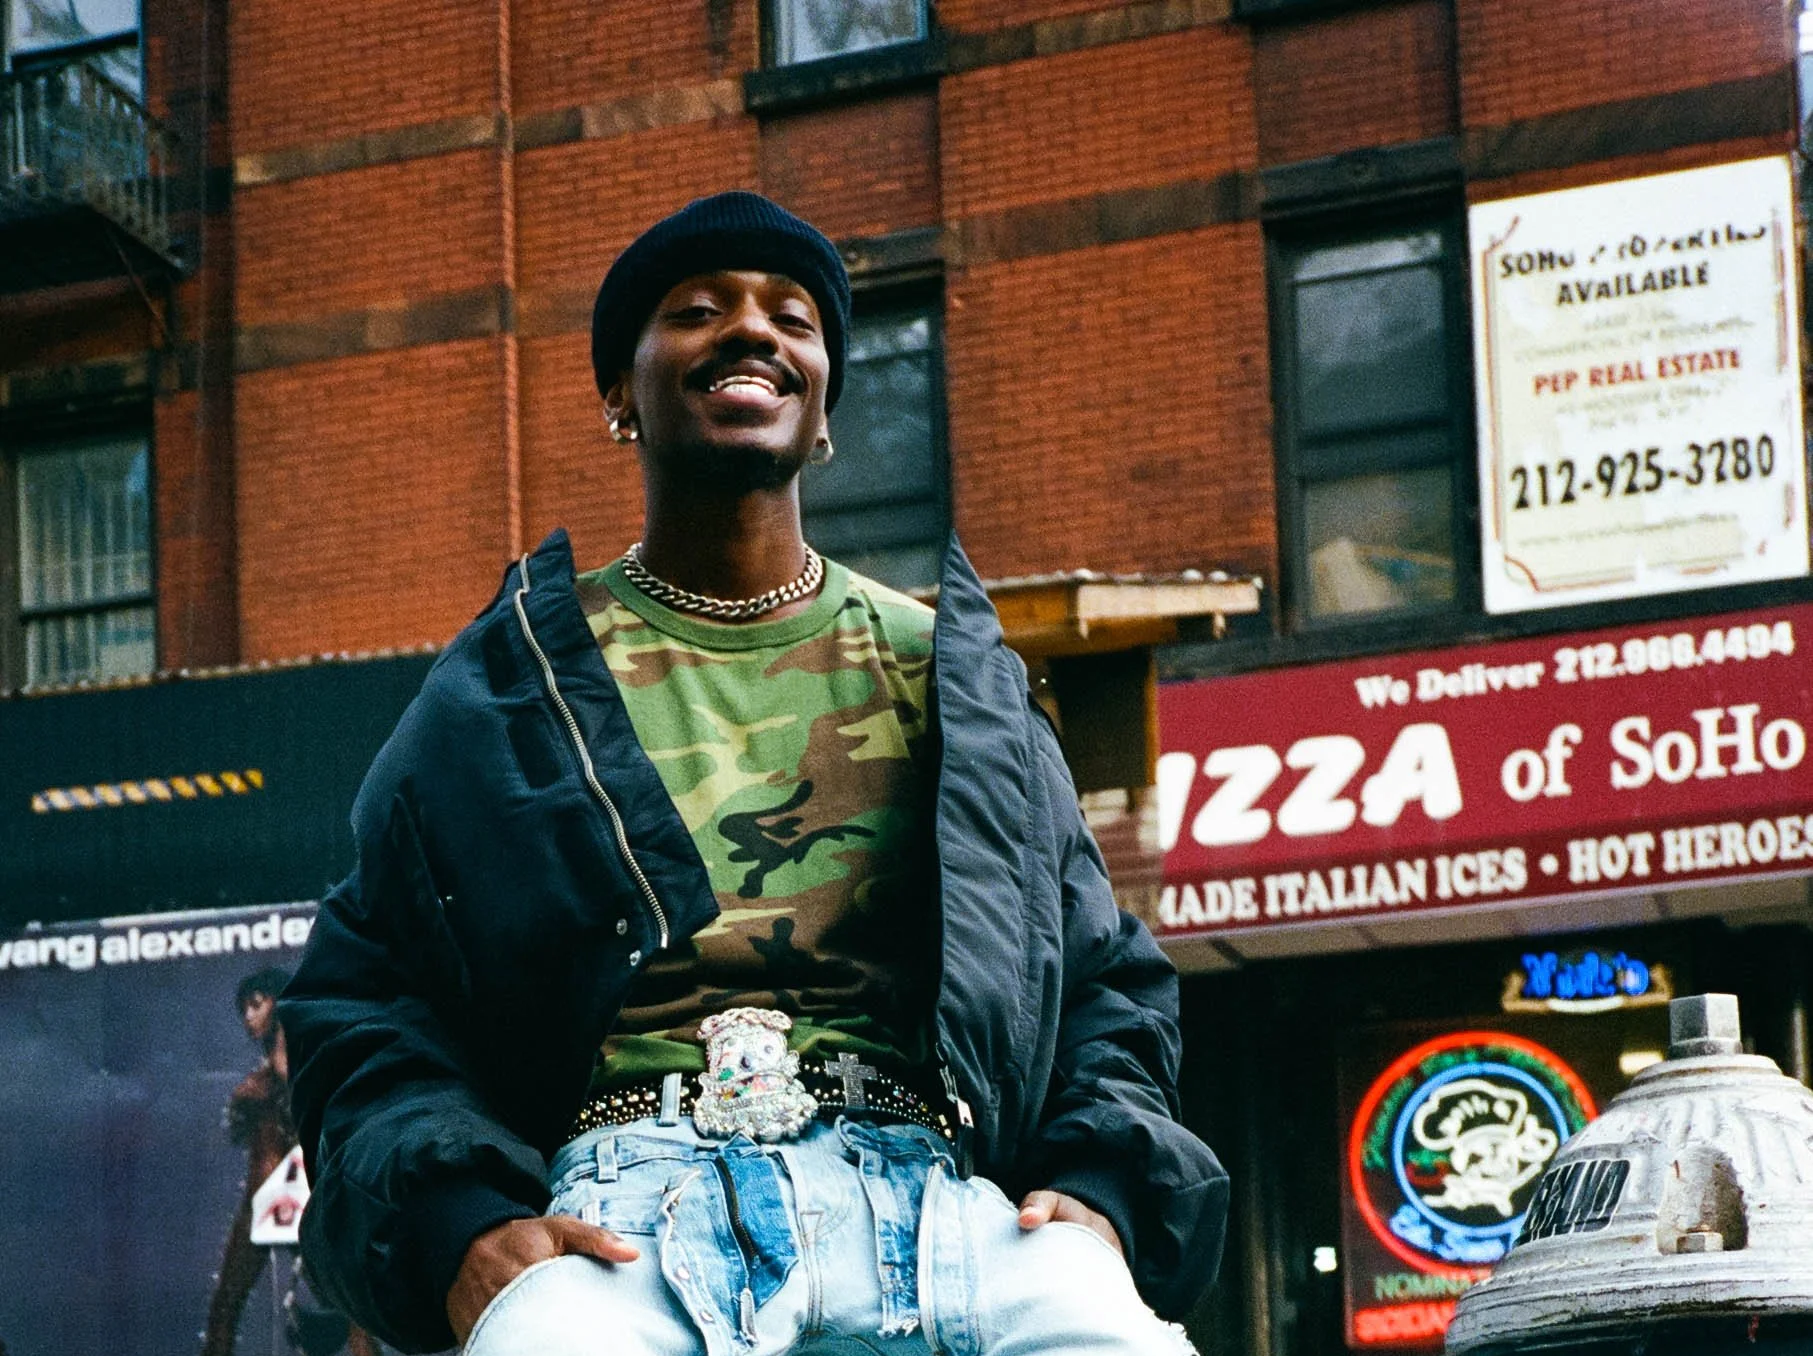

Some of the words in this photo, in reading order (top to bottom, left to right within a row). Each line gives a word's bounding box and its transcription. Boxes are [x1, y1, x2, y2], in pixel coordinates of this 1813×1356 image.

[1557, 261, 1710, 306] AVAILABLE
[1533, 371, 1579, 395] PEP
[1588, 361, 1645, 387] REAL
[1657, 349, 1740, 379] ESTATE
[1354, 675, 1410, 709] We
[1416, 662, 1545, 701] Deliver
[1502, 724, 1583, 802] of
[1609, 704, 1806, 790] SoHo
[1264, 858, 1427, 917] ITALIAN
[1435, 847, 1528, 898] ICES
[1568, 831, 1655, 884] HOT
[101, 913, 316, 964] alexande
